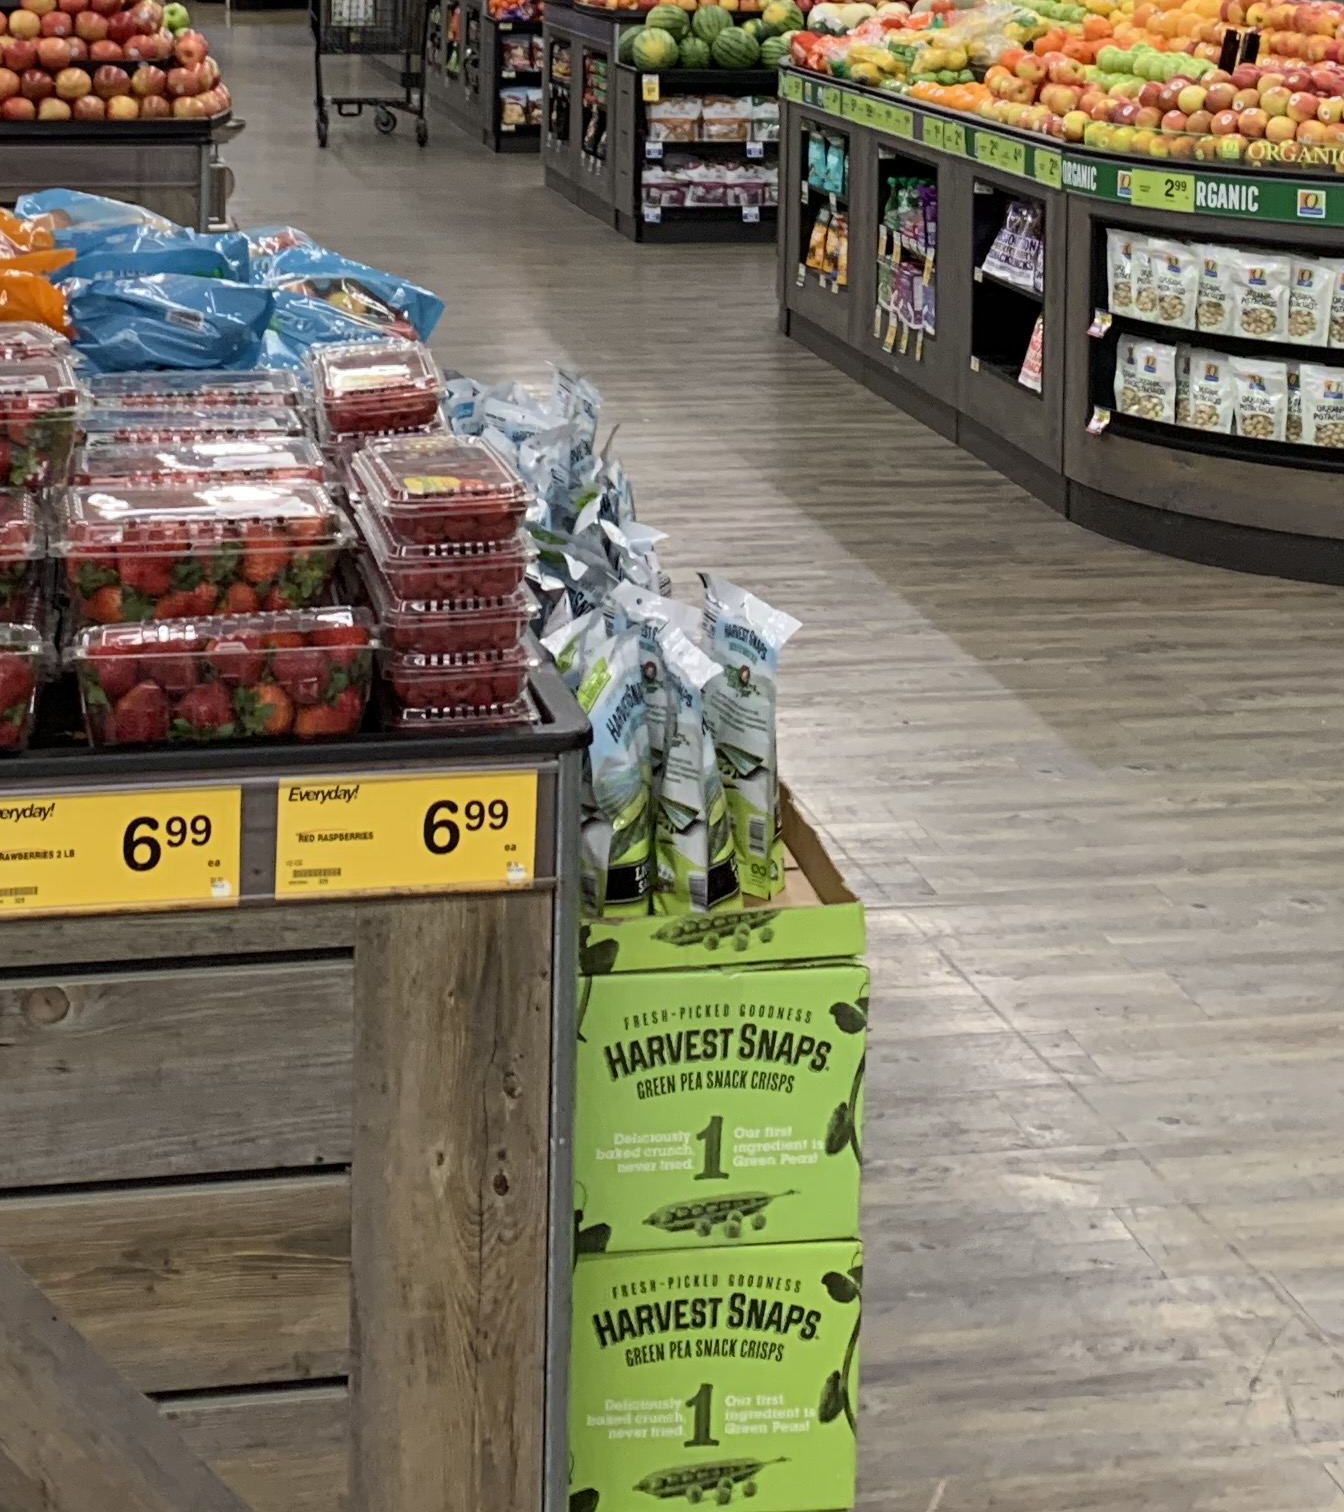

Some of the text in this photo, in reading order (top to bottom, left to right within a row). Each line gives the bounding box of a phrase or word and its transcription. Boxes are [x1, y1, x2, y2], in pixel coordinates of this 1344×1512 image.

[1063, 153, 1097, 191] ORGANIC
[1196, 181, 1259, 212] RGANIC
[288, 785, 359, 804] Everyday!
[298, 831, 373, 843] RED RASPBERRIES
[56, 850, 62, 859] 2
[64, 849, 75, 858] LB
[624, 1004, 812, 1031] FRESH-PICKED GOODNESS
[604, 1023, 832, 1082] HARVEST SNAPS
[636, 1070, 794, 1100] GREEN PEA SNACK CRISPS
[734, 1125, 793, 1139] Our first
[693, 1115, 729, 1181] 1
[733, 1138, 825, 1155] ingredient is
[617, 1162, 656, 1174] never
[733, 1154, 777, 1168] Green
[612, 1274, 802, 1299] FRESH-PICKED GOODNESS
[592, 1292, 822, 1350] HARVEST SNAPS
[625, 1338, 785, 1367] GREEN PEA SNACK CRISPS
[725, 1394, 784, 1407] Our first
[683, 1383, 720, 1448] 1
[725, 1407, 817, 1422] ingredient is
[608, 1428, 647, 1440] never
[724, 1422, 768, 1435] Green
